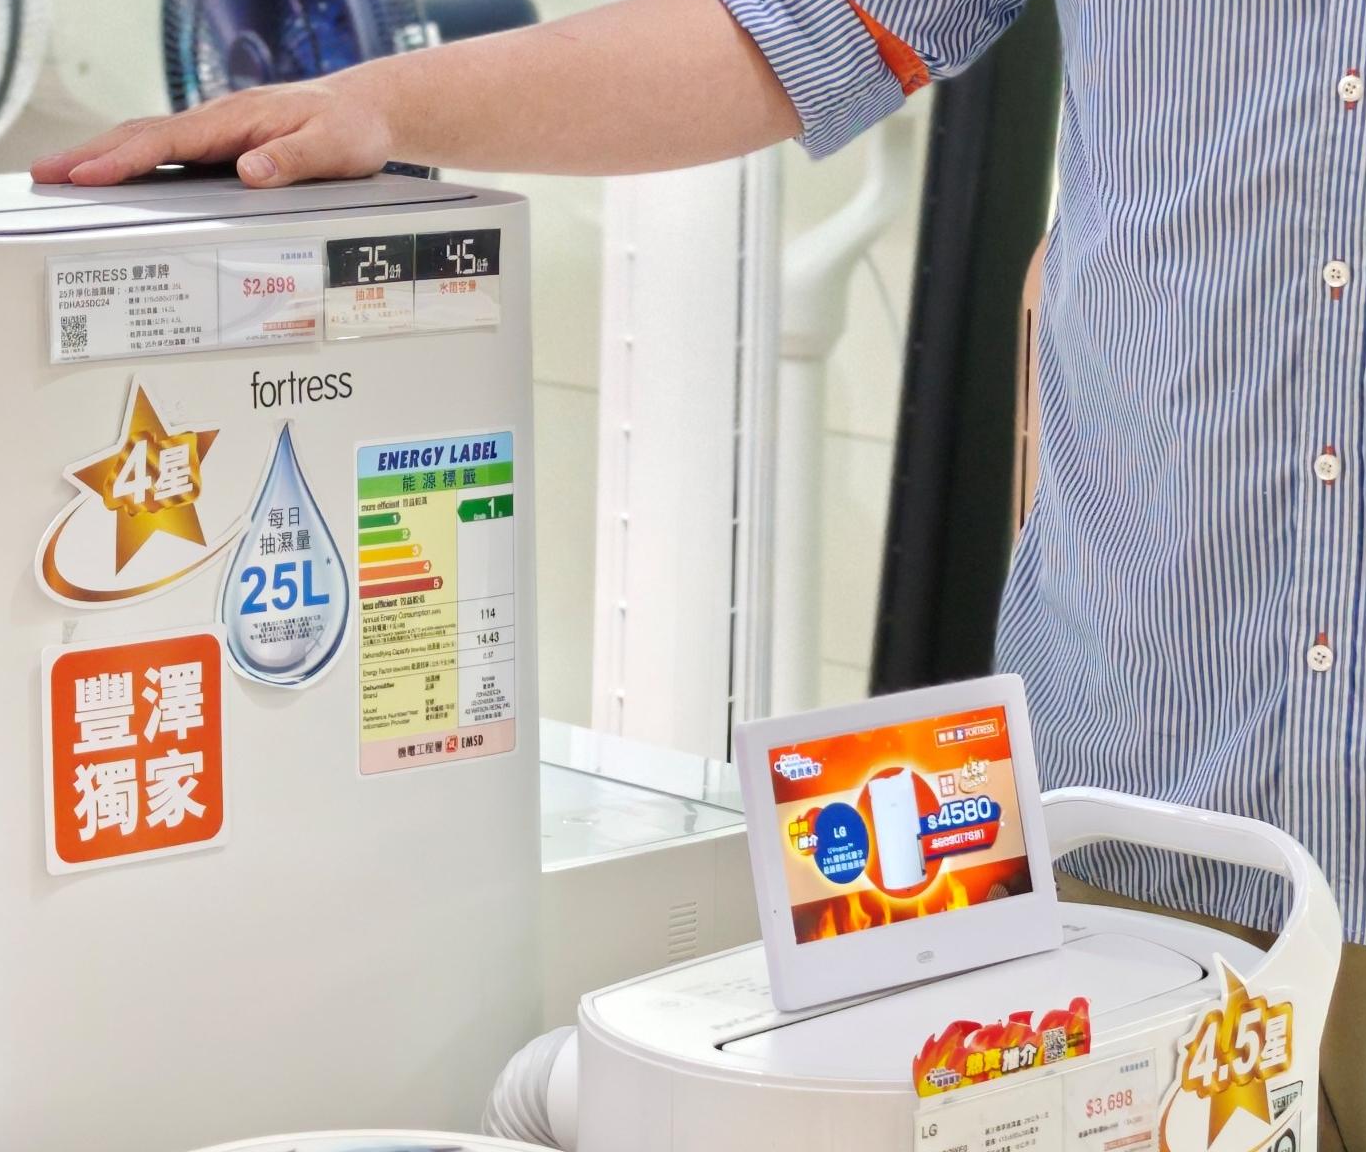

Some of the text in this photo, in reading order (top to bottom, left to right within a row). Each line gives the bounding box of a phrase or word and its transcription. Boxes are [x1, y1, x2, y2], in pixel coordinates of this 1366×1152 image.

[57, 263, 170, 286] FORTRESS 豐澤牌
[242, 276, 295, 298] $2,898
[250, 370, 354, 410] fortress
[378, 439, 498, 473] ENERGY LABEL
[112, 439, 195, 505] 4星
[402, 467, 477, 493] 能源標籤
[268, 506, 300, 529] 每日
[377, 499, 400, 510] efficient
[487, 497, 495, 518] 1
[260, 529, 312, 556] 抽濕量
[240, 559, 330, 615] 25L
[481, 608, 496, 620] 114
[477, 632, 500, 646] 14.43
[73, 661, 204, 754] 豐澤
[397, 735, 484, 758] 機電工程署 EMSD
[73, 749, 208, 842] 獨家
[927, 797, 992, 829] $4580
[833, 825, 847, 839] LG
[1002, 1043, 1037, 1073] 推介
[1188, 1008, 1288, 1087] 4.5星
[1085, 1089, 1133, 1119] $3,698
[921, 1123, 938, 1140] LG
